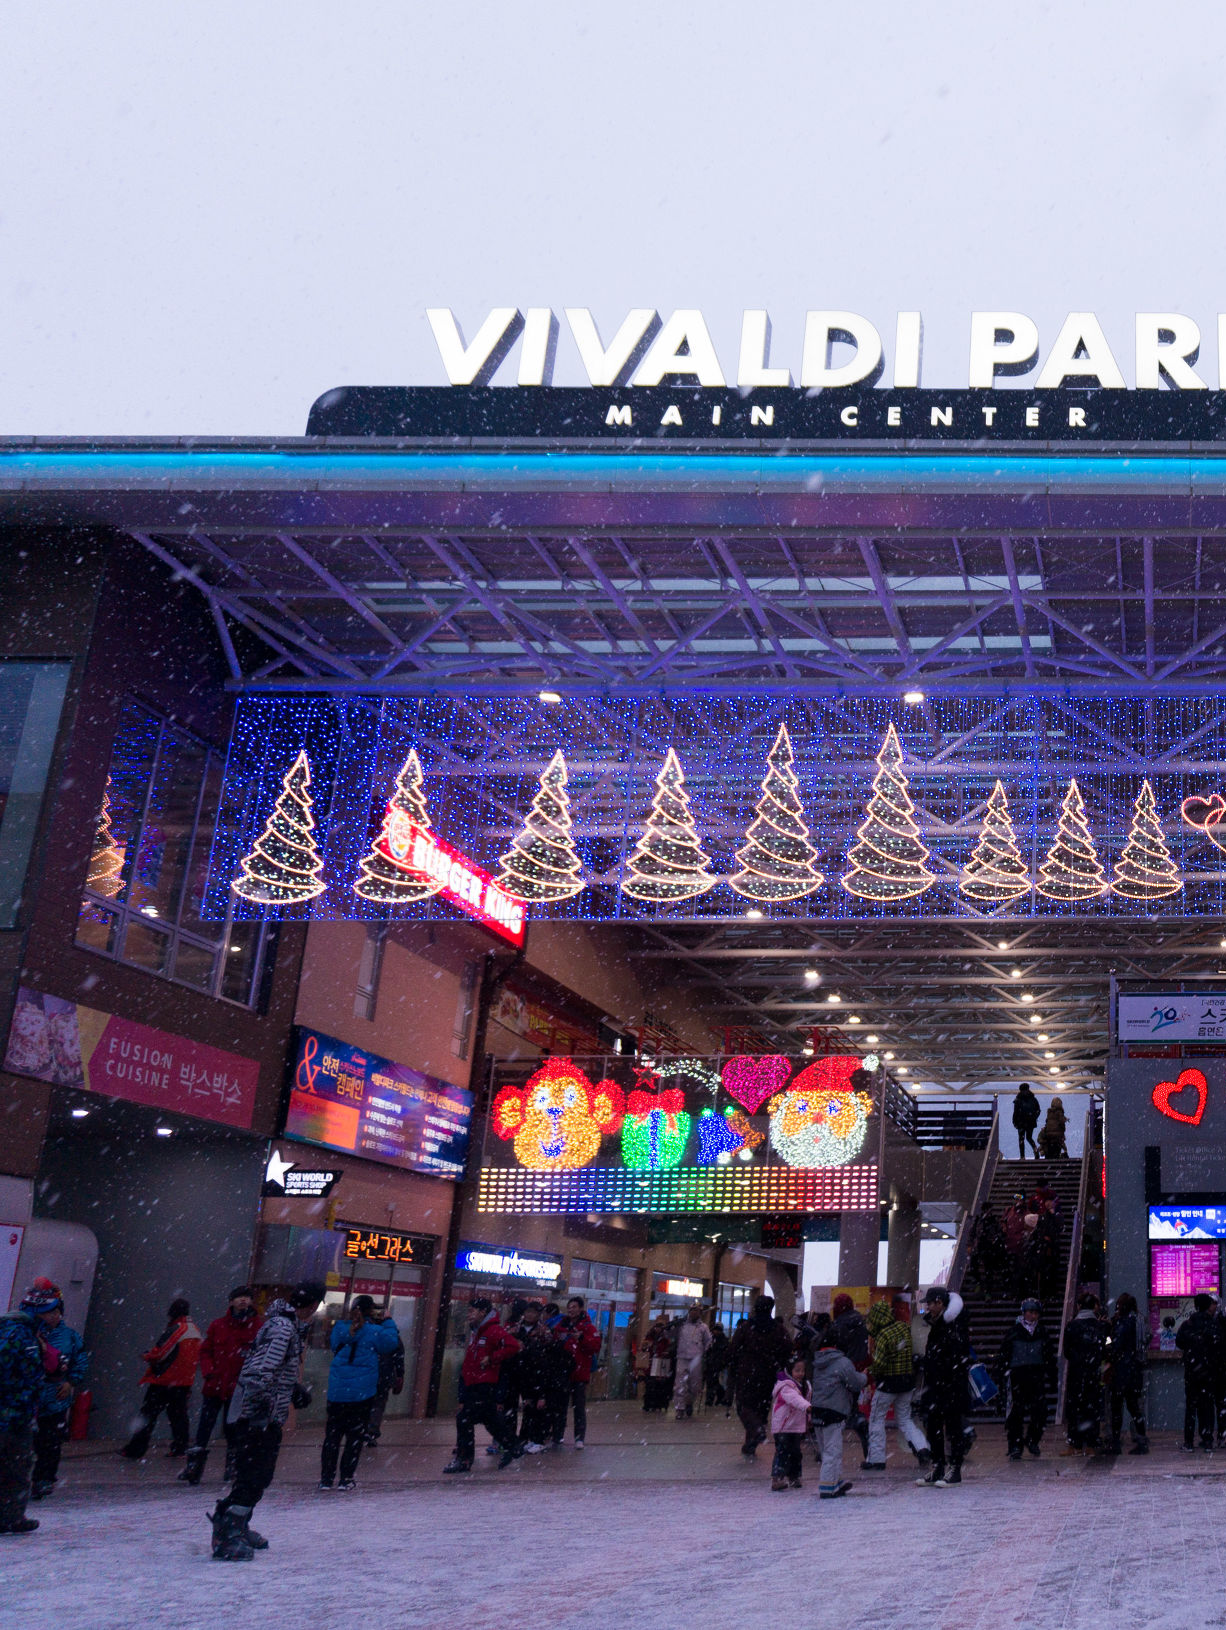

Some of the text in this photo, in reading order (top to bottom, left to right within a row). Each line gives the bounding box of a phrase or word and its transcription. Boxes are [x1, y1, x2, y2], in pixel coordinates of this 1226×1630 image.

[425, 308, 921, 388] VIVALDI
[605, 405, 1088, 427] MAIN CENTER
[484, 884, 523, 935] KING
[1197, 1026, 1224, 1037] 흡연은
[109, 1037, 173, 1069] FUSION
[322, 1055, 341, 1077] 안전
[106, 1060, 170, 1089] CUISINE
[180, 1063, 242, 1105] 박스박스
[336, 1072, 365, 1101] 캠페인
